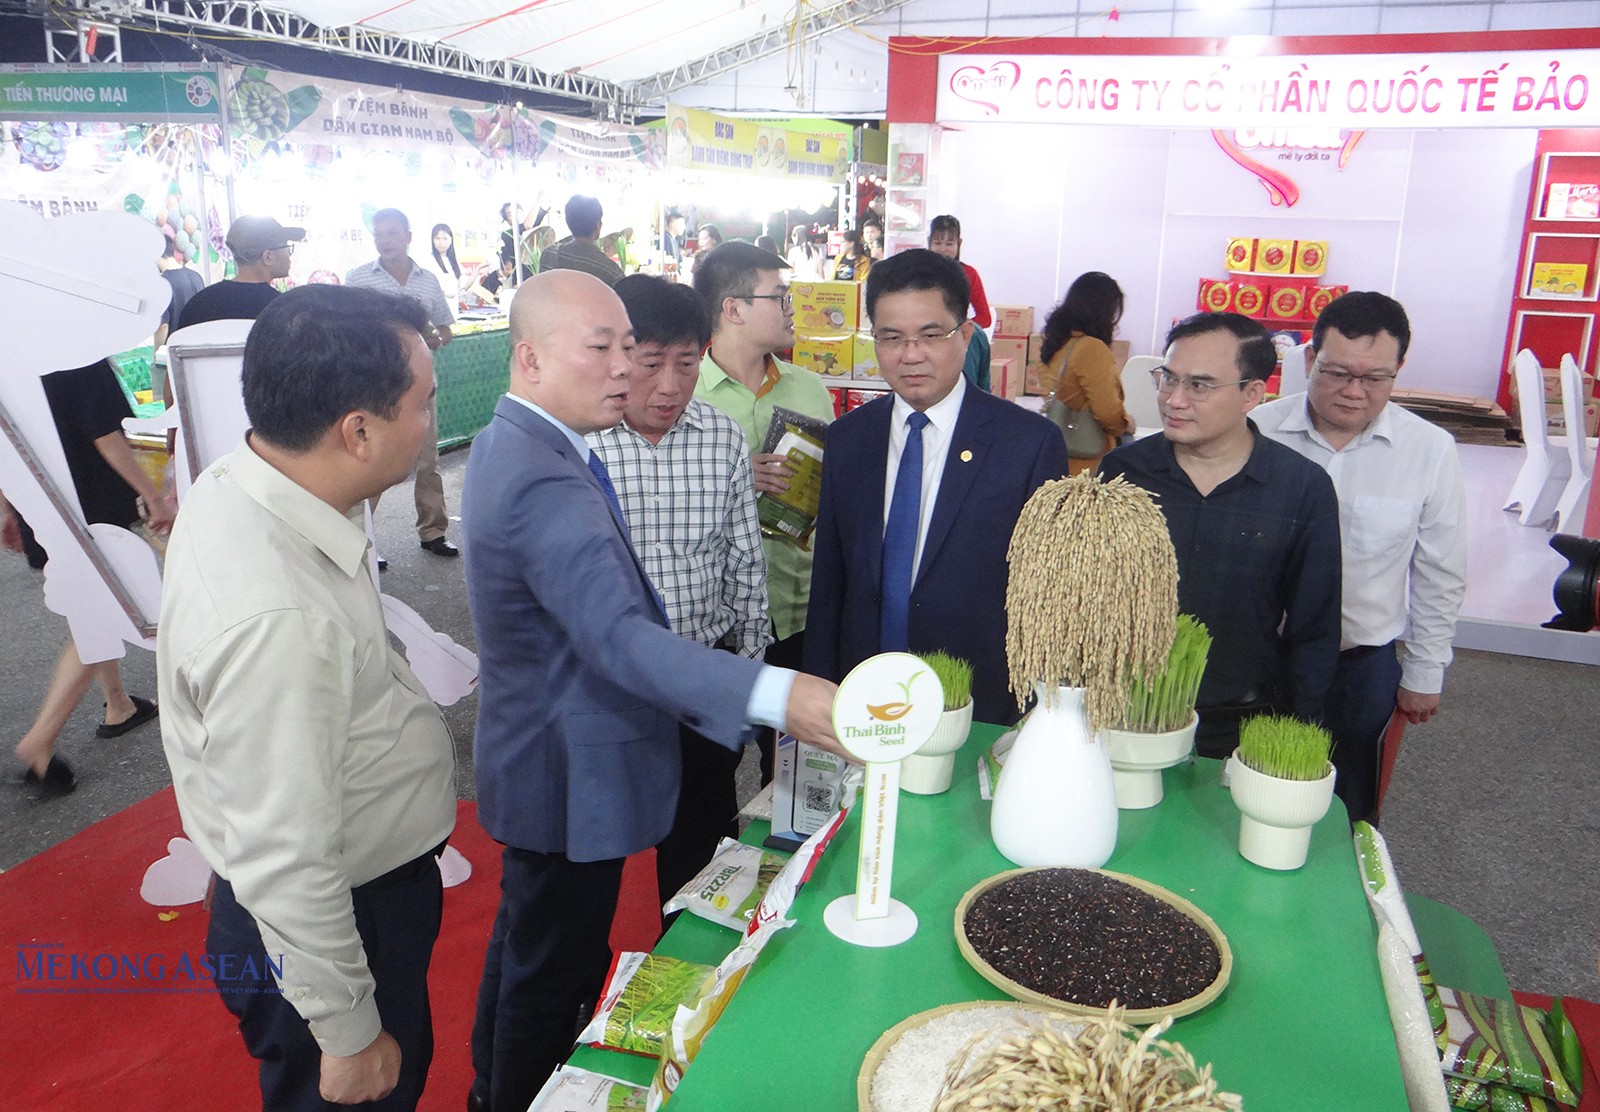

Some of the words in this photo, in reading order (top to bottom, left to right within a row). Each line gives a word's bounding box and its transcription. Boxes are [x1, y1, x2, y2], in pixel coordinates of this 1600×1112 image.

[3, 80, 33, 101] TIẾN
[36, 84, 95, 102] THƯƠNG
[100, 86, 128, 107] MẠI
[1035, 68, 1119, 112] CÔNG
[1132, 79, 1170, 112] TY
[1182, 64, 1231, 113] CỔ
[1347, 65, 1443, 114] QUỐC
[1457, 62, 1510, 112] TẾ
[1512, 60, 1590, 112] BẢO
[347, 97, 386, 117] TIỆM
[322, 116, 356, 134] DÂN
[360, 122, 403, 137] GIAN
[404, 126, 433, 141] NAM
[436, 128, 454, 146] BỘ
[879, 735, 905, 746] Seed
[700, 865, 742, 902] TBR225
